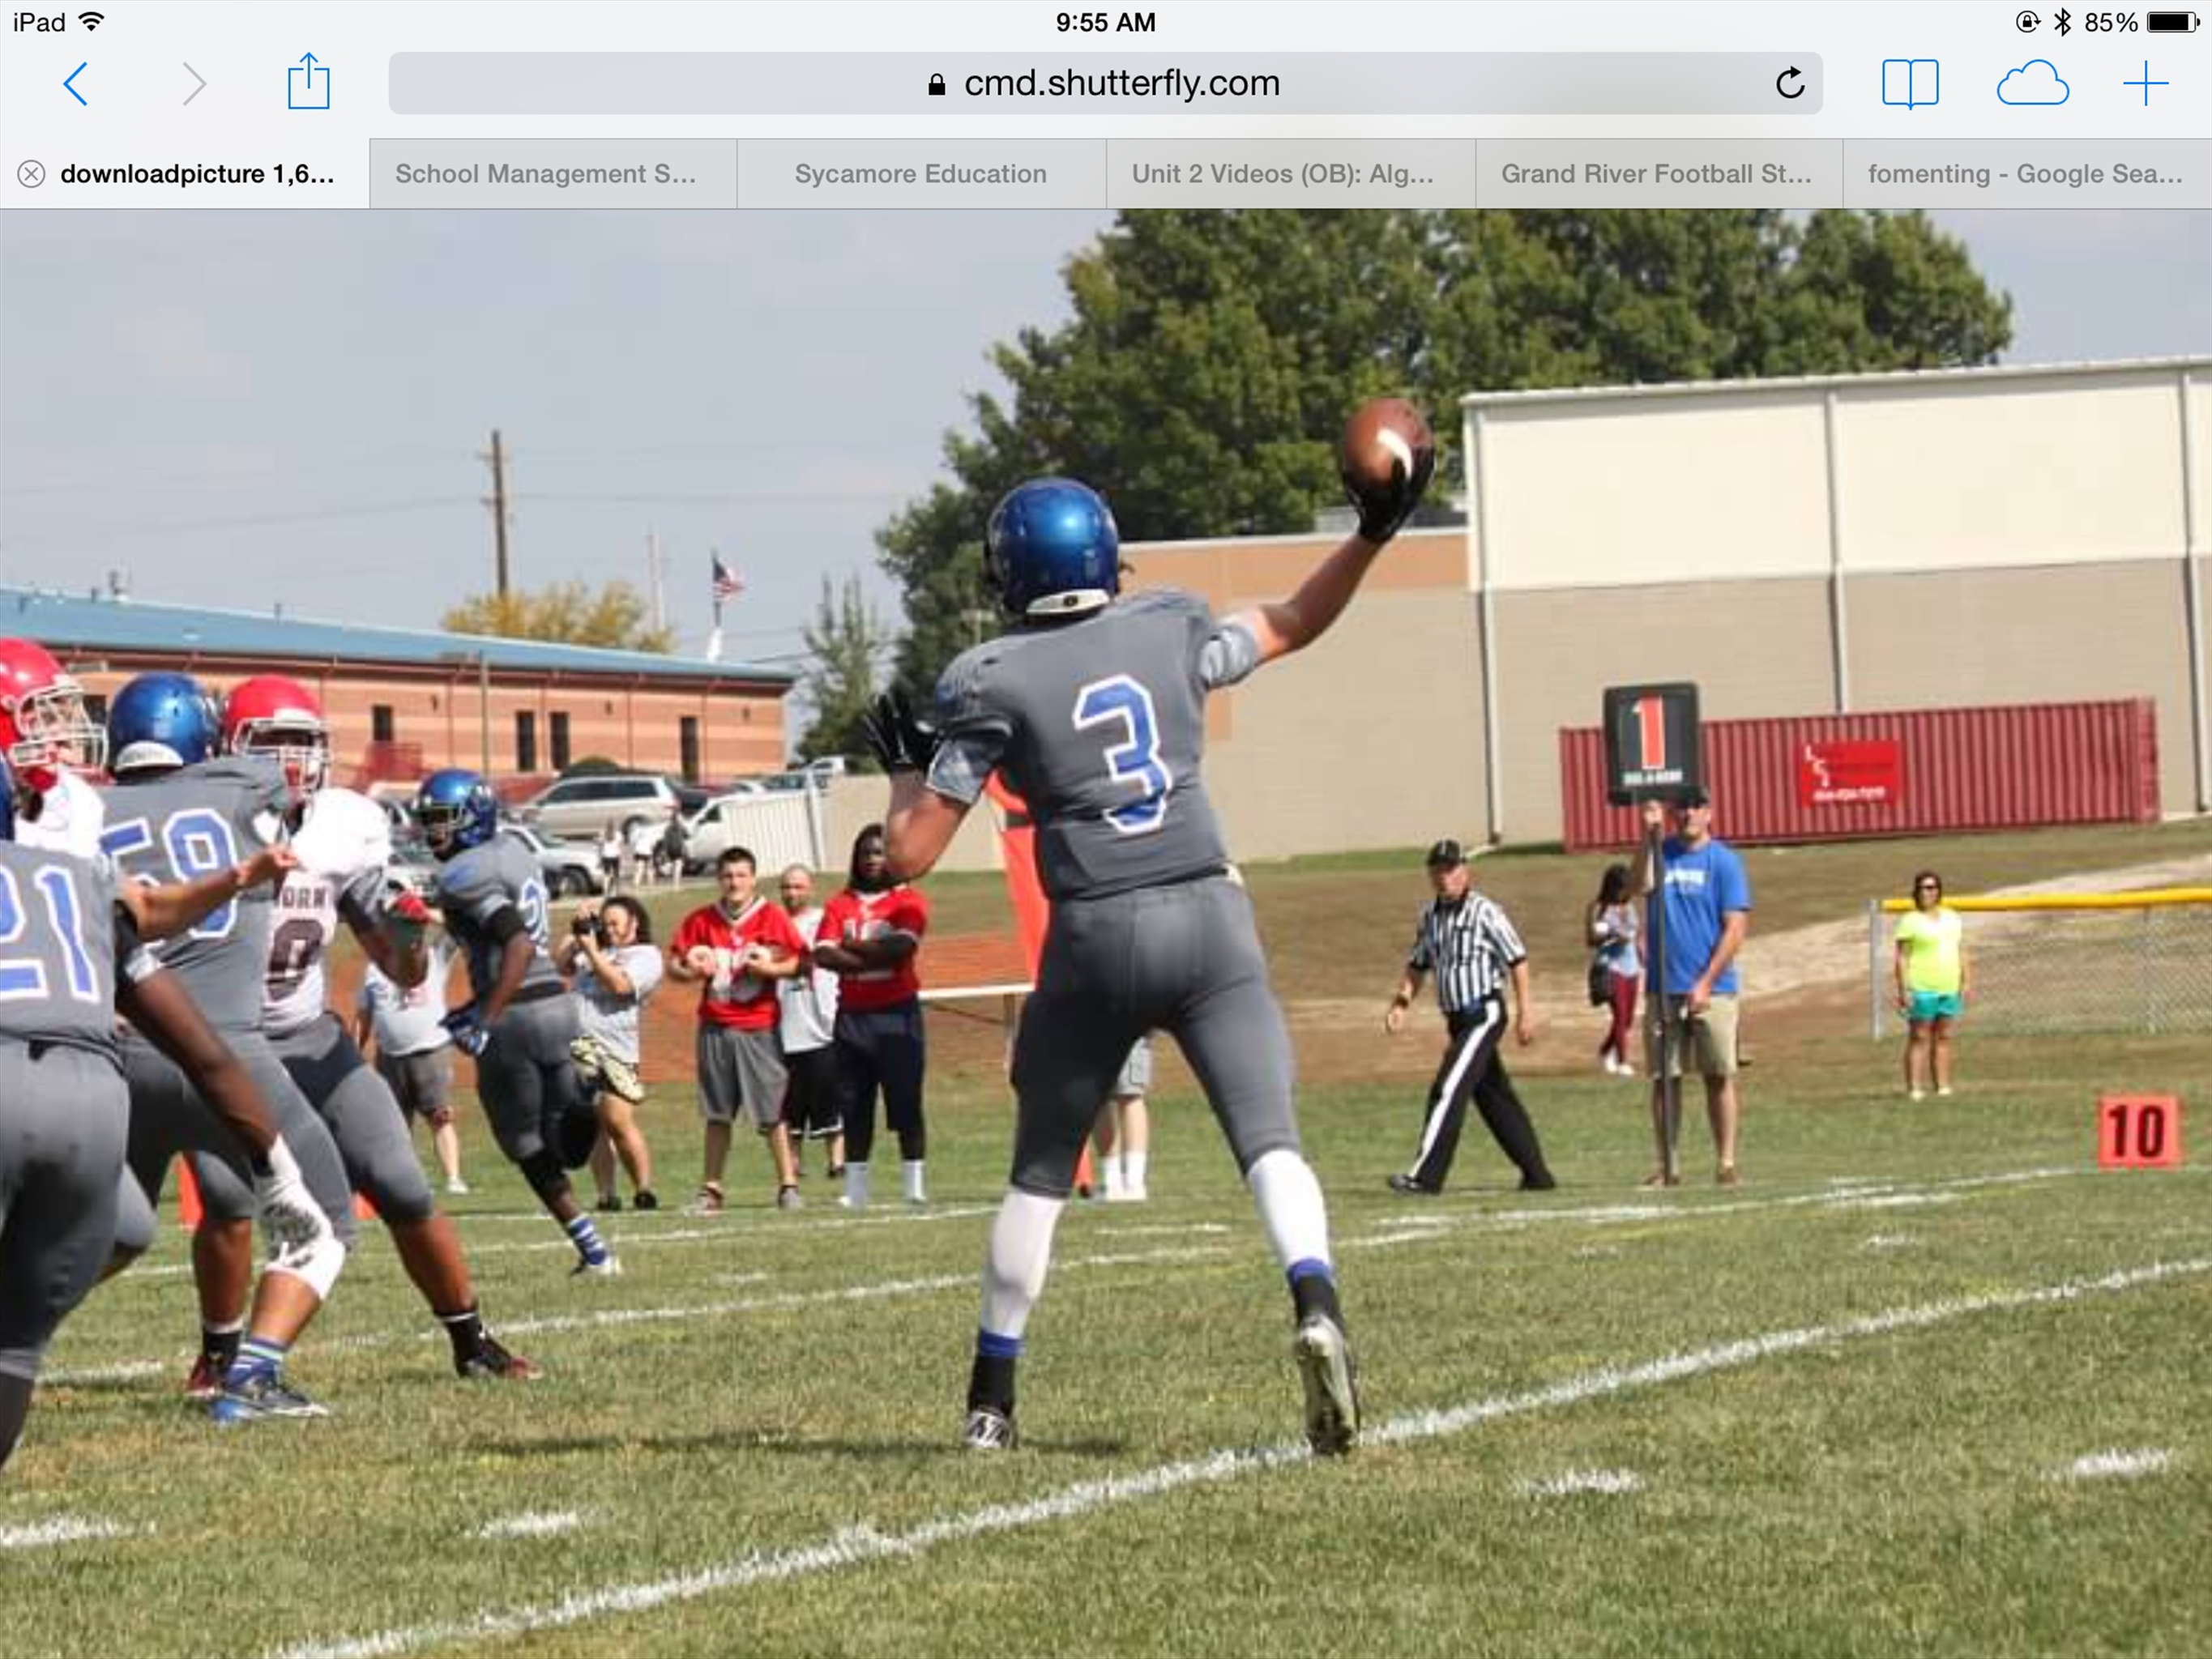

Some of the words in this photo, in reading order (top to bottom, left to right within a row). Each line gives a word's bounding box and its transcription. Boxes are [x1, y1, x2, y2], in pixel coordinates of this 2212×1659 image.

[1072, 672, 1174, 834] 3
[1632, 695, 1666, 770] 1
[2107, 1104, 2165, 1158] 10
